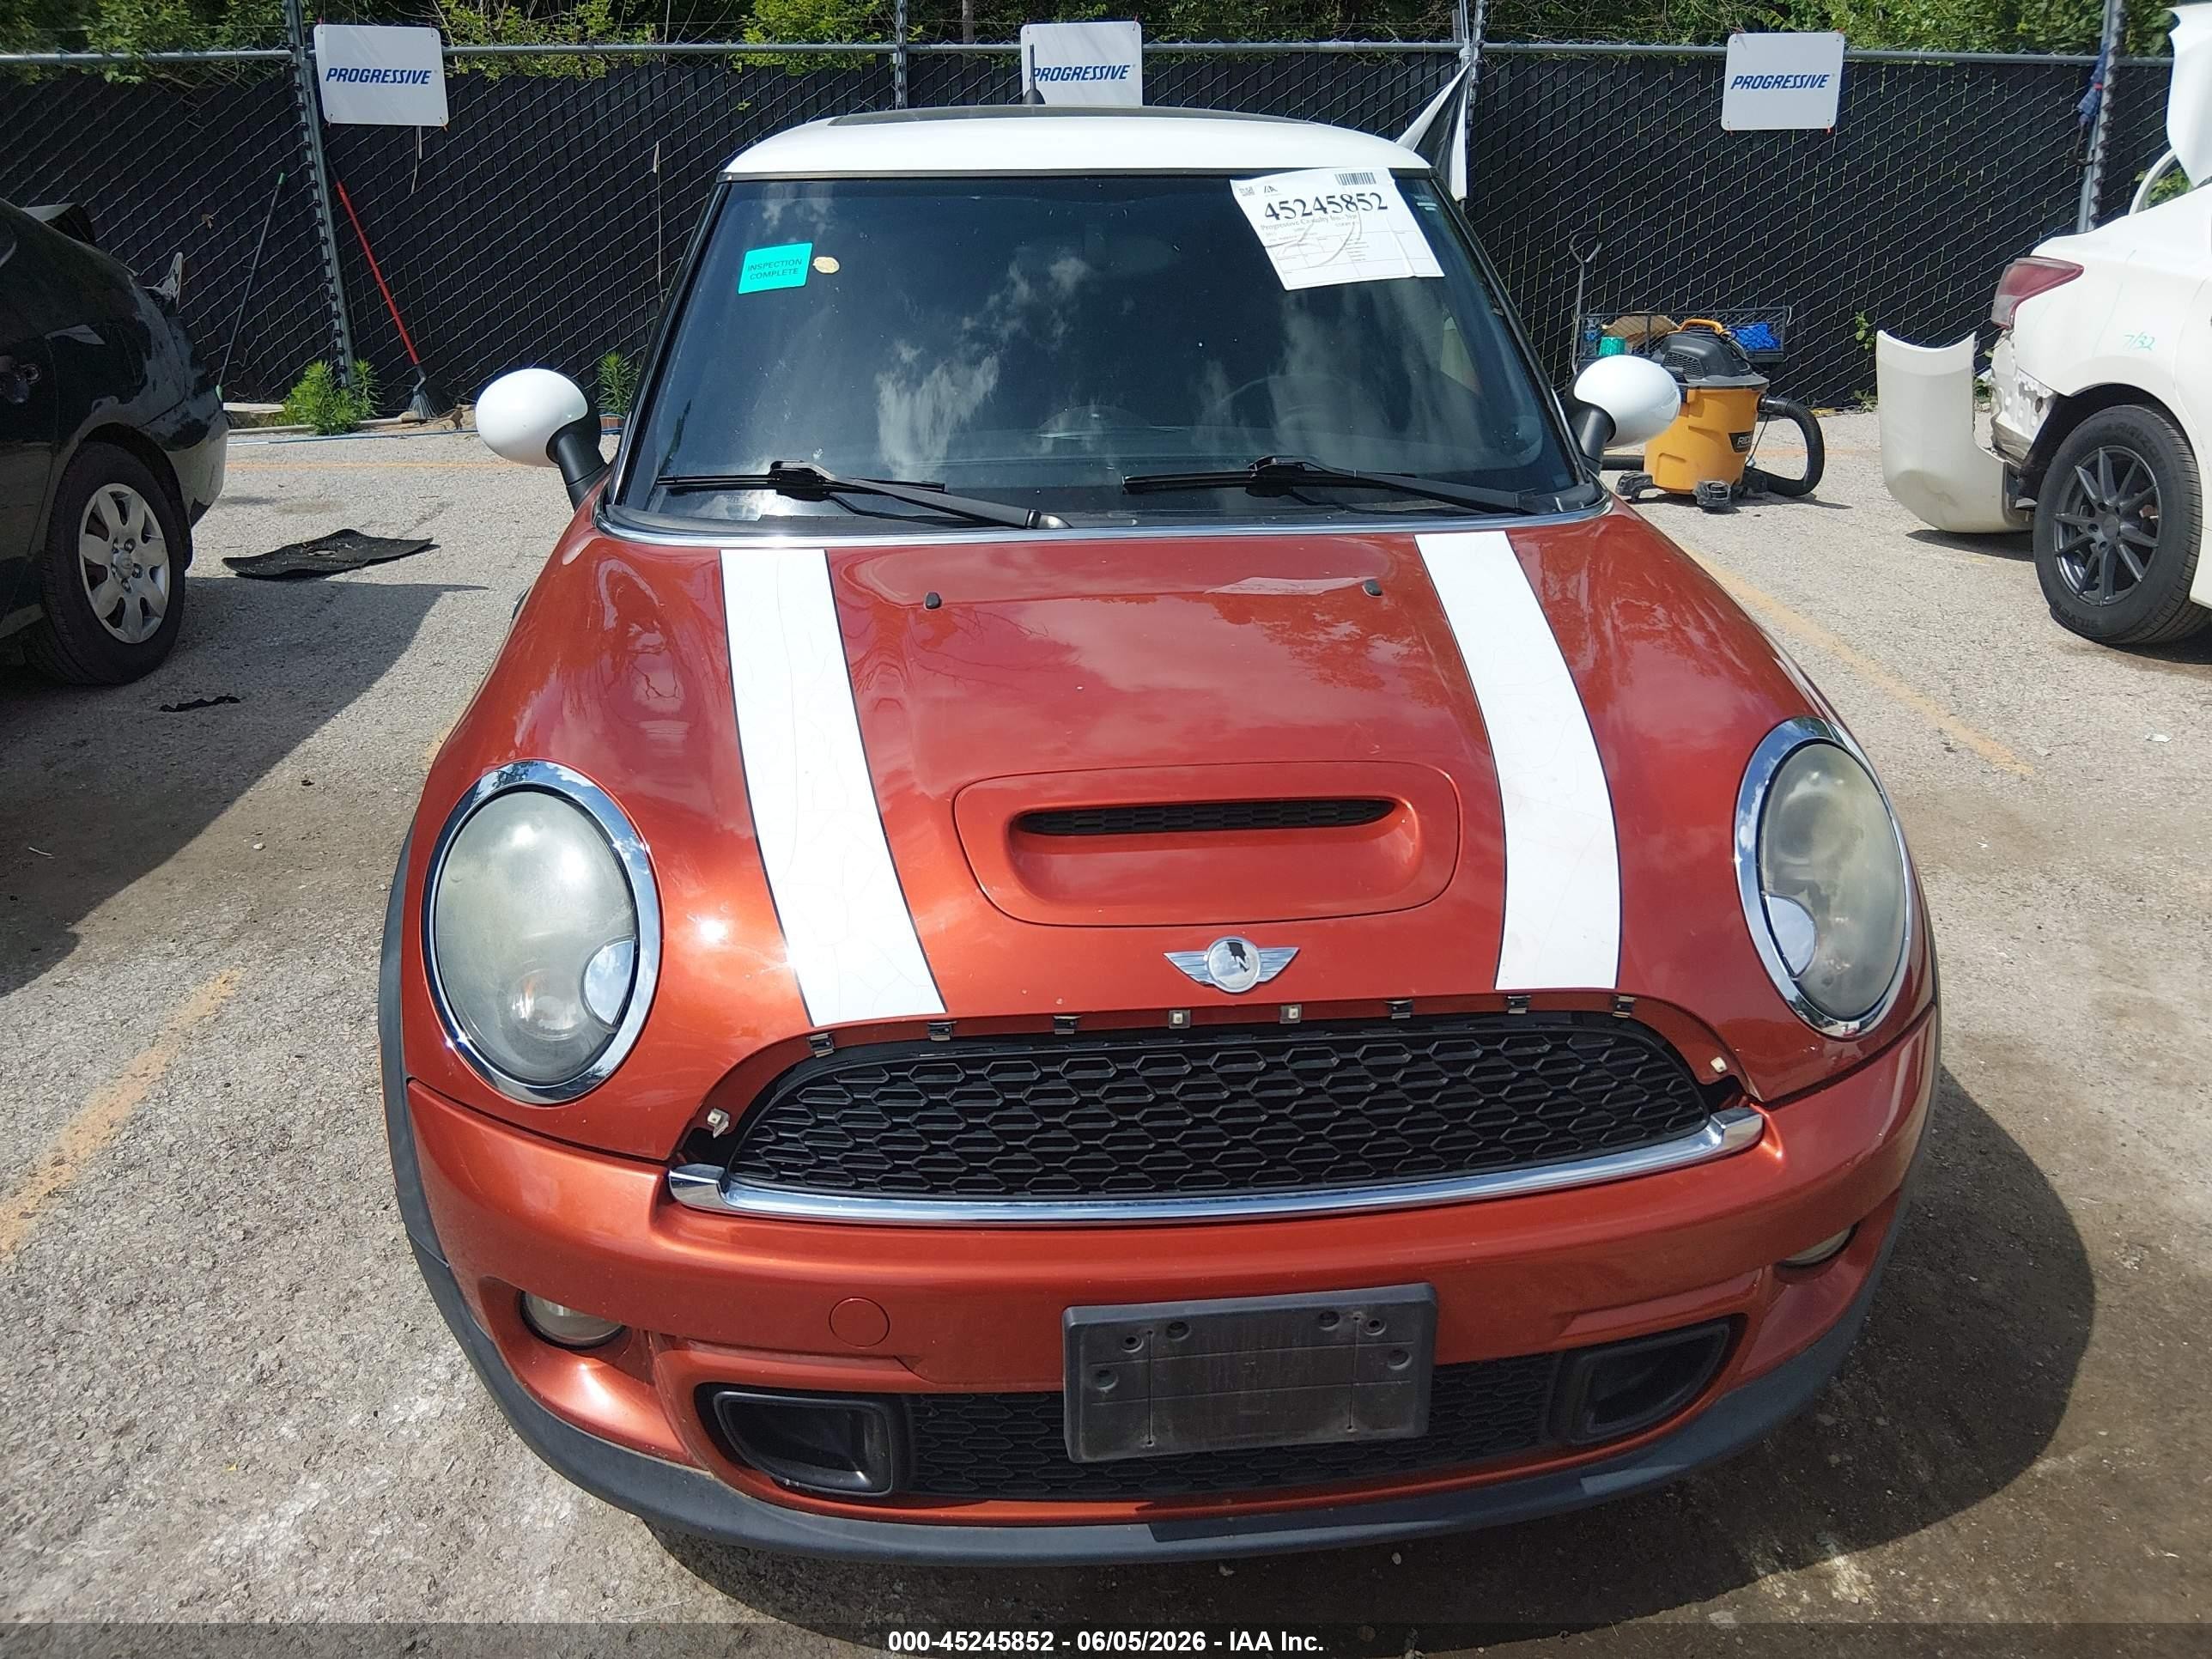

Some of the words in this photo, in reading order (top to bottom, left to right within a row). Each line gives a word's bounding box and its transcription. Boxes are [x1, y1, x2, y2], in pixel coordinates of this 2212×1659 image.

[326, 67, 432, 84] PROGRESSIVE
[1030, 64, 1131, 82] PROGRESSIVE
[1730, 74, 1831, 90] PROGRESSIVE
[1264, 191, 1388, 221] 45245852
[747, 258, 802, 271] INSPECTION
[750, 267, 799, 281] COMPLETE
[2124, 331, 2155, 351] 7/32
